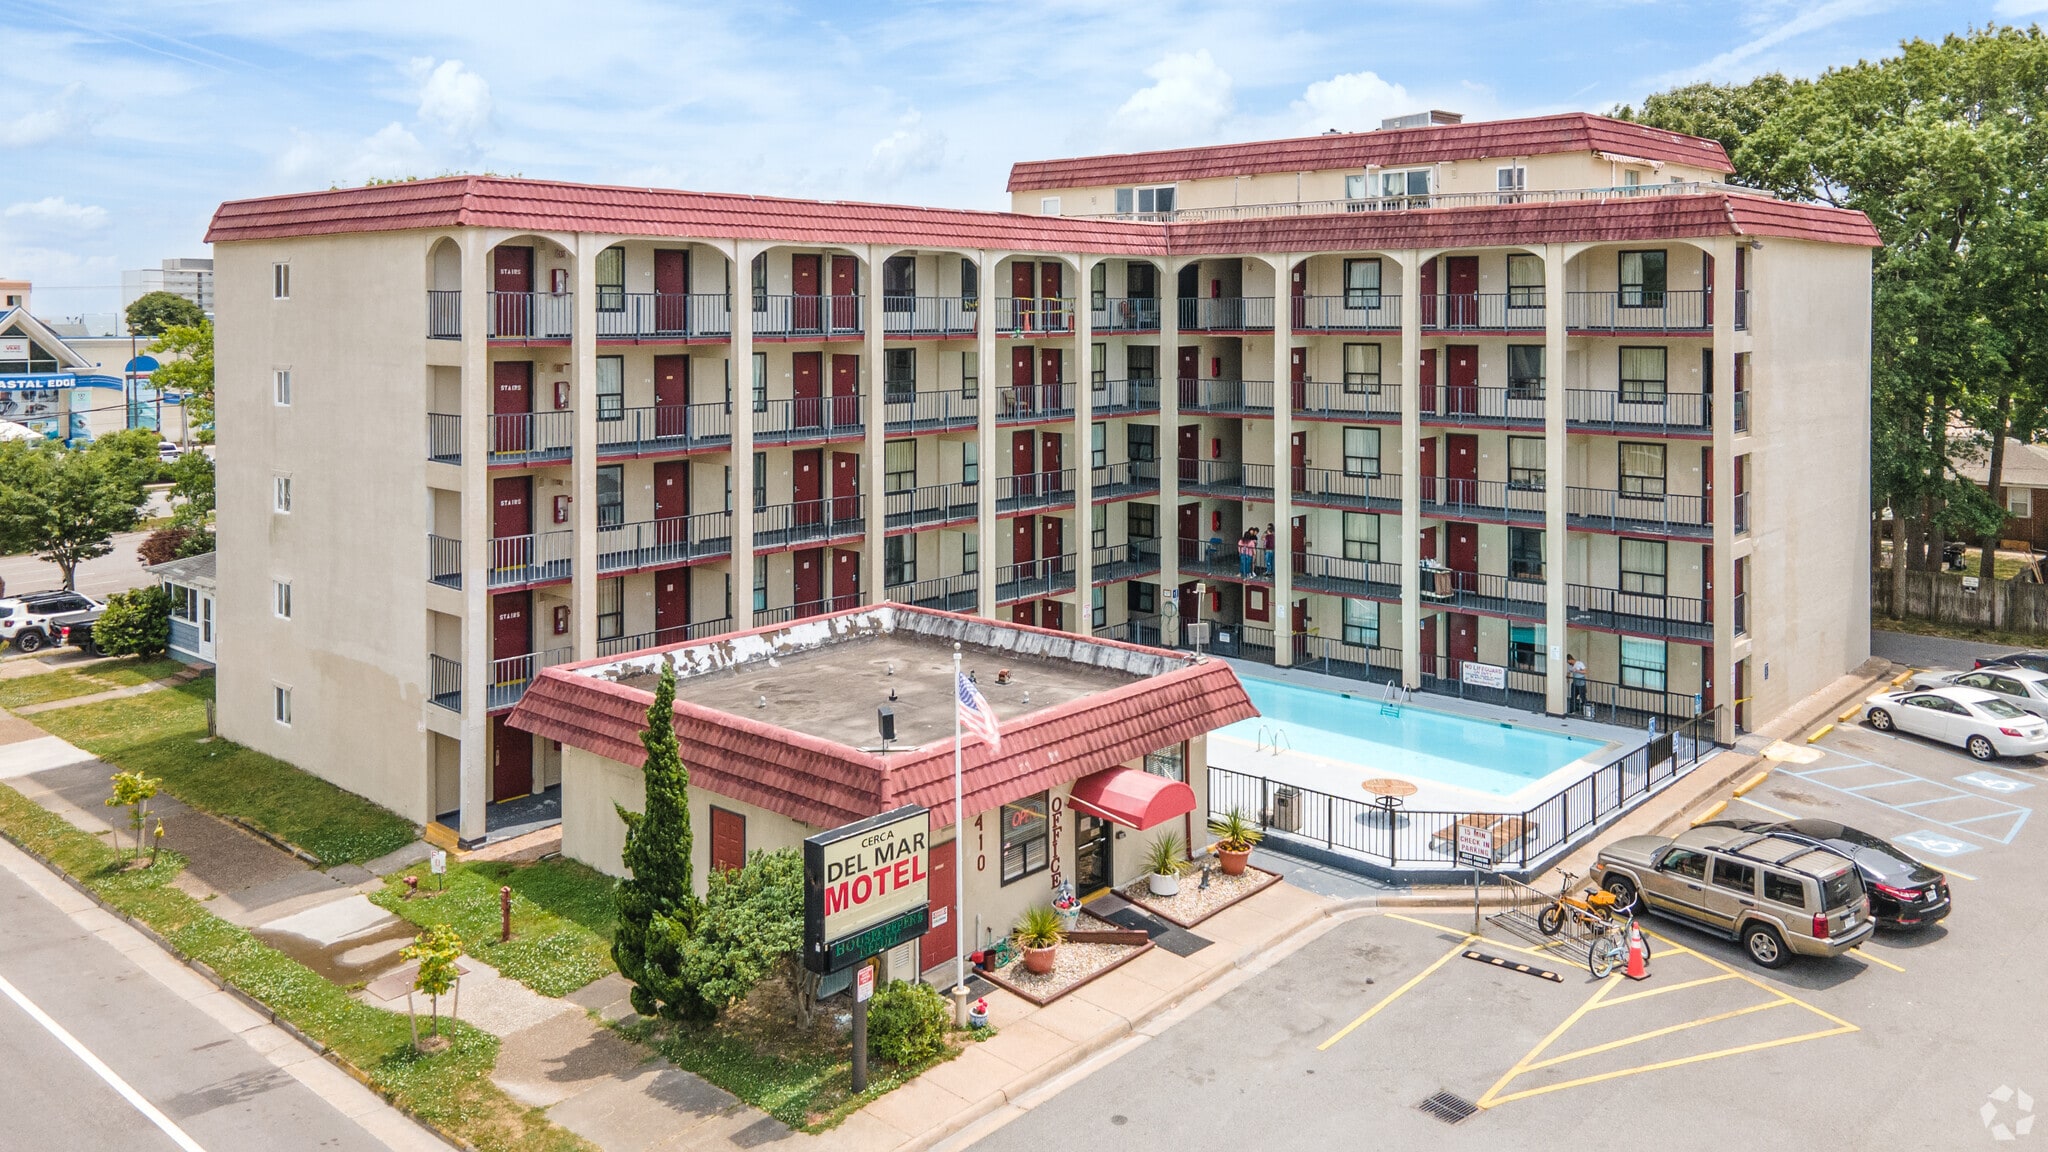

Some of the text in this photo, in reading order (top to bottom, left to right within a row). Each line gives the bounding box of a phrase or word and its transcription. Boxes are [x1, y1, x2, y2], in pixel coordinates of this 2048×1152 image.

[47, 379, 76, 388] EDGE
[500, 499, 521, 507] STAIRS
[499, 612, 521, 620] STAIRS
[861, 830, 894, 848] CERCA
[1473, 829, 1486, 839] MIN
[974, 813, 986, 872] 410
[1050, 796, 1063, 890] OFFICE
[1460, 836, 1481, 846] CHECK
[1461, 844, 1489, 856] PARKING
[827, 832, 925, 884] DEL MAR
[825, 855, 927, 917] MOTEL
